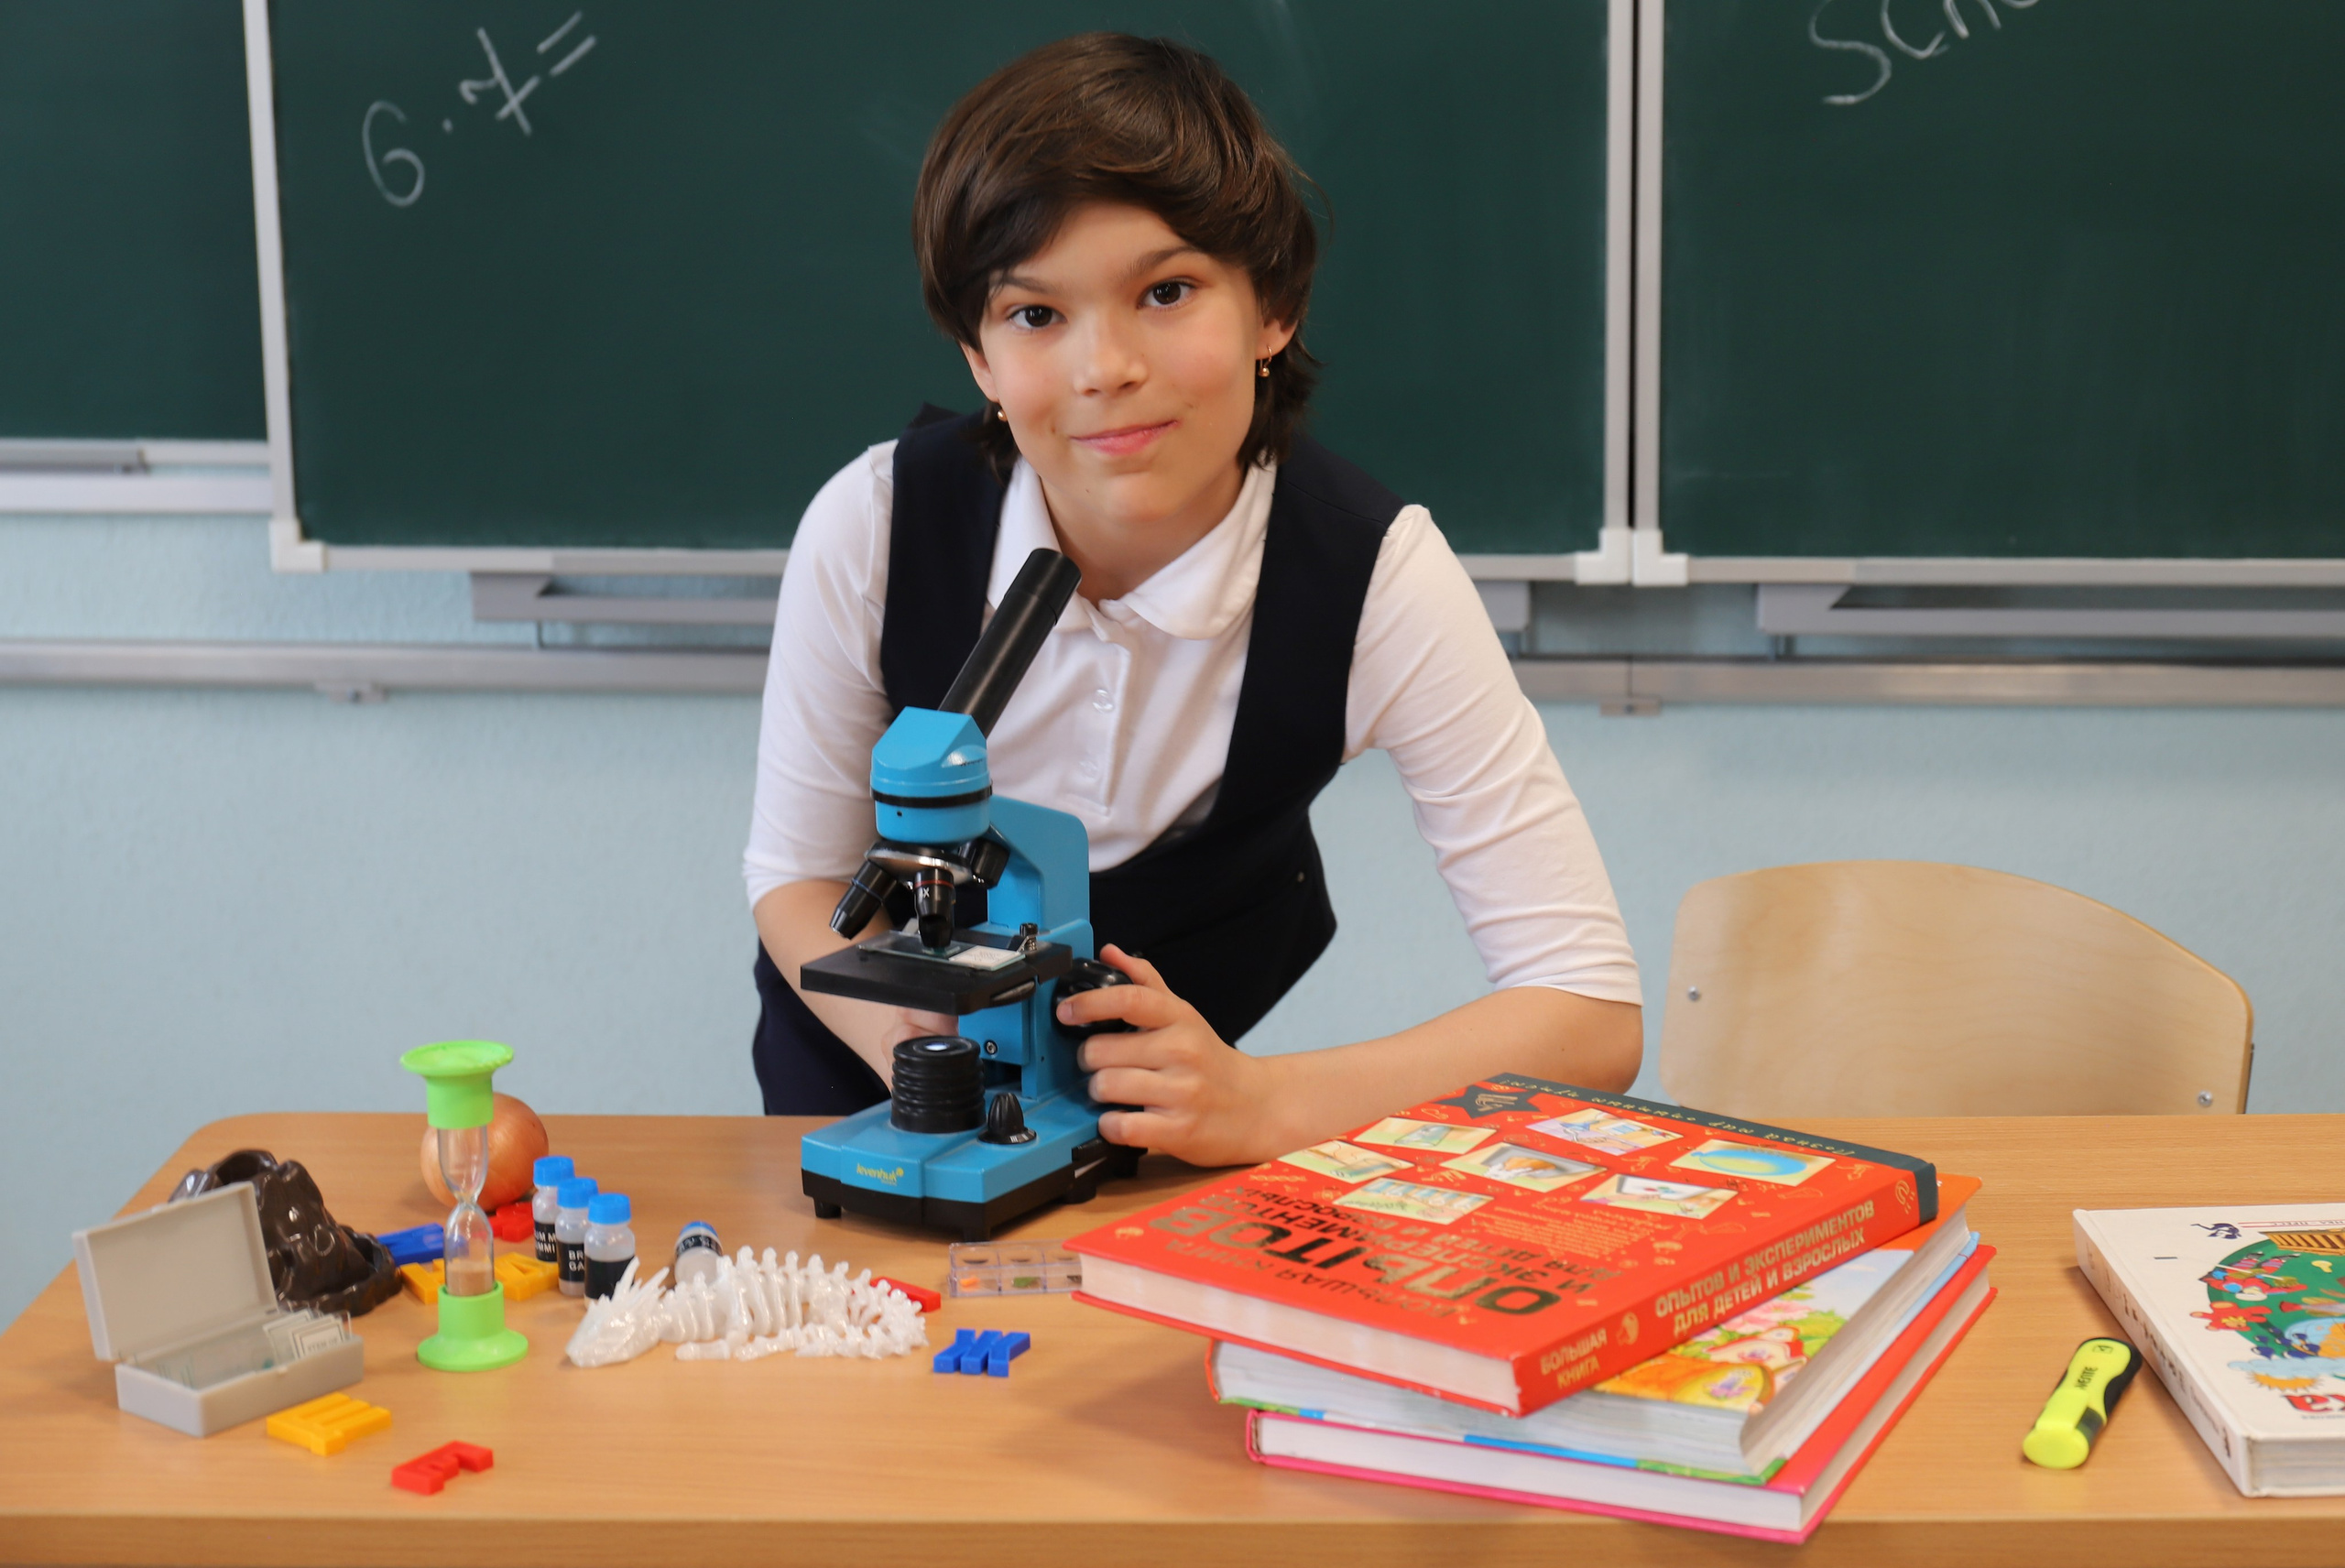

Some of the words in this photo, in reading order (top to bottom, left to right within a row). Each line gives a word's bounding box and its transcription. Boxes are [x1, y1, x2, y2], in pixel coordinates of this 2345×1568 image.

[1235, 1186, 1399, 1230] ВЗРОСЛЫХ
[1198, 1194, 1550, 1283] ЭКСПЕРИМЕНТОВ
[1400, 1225, 1431, 1237] И
[1431, 1233, 1545, 1262] ДЕТЕЙ
[1148, 1205, 1562, 1315] ОПЫТОВ
[1165, 1238, 1274, 1272] КНИГА
[1543, 1257, 1624, 1281] ДЛЯ
[1655, 1272, 1725, 1318] ОПЫТОВ
[1729, 1262, 1740, 1284] И
[1744, 1200, 1876, 1277] ЭКСПЕРИМЕНТОВ
[1275, 1268, 1458, 1317] БОЛЬШАЯ
[1555, 1278, 1598, 1294] И
[1674, 1303, 1710, 1338] ДЛЯ
[1713, 1272, 1763, 1320] ДЕТЕЙ
[1766, 1268, 1779, 1290] И
[1783, 1228, 1866, 1282] ВЗРОСЛЫХ
[1540, 1327, 1608, 1376] БОЛЬШАЯ
[1557, 1355, 1600, 1389] КНИГА
